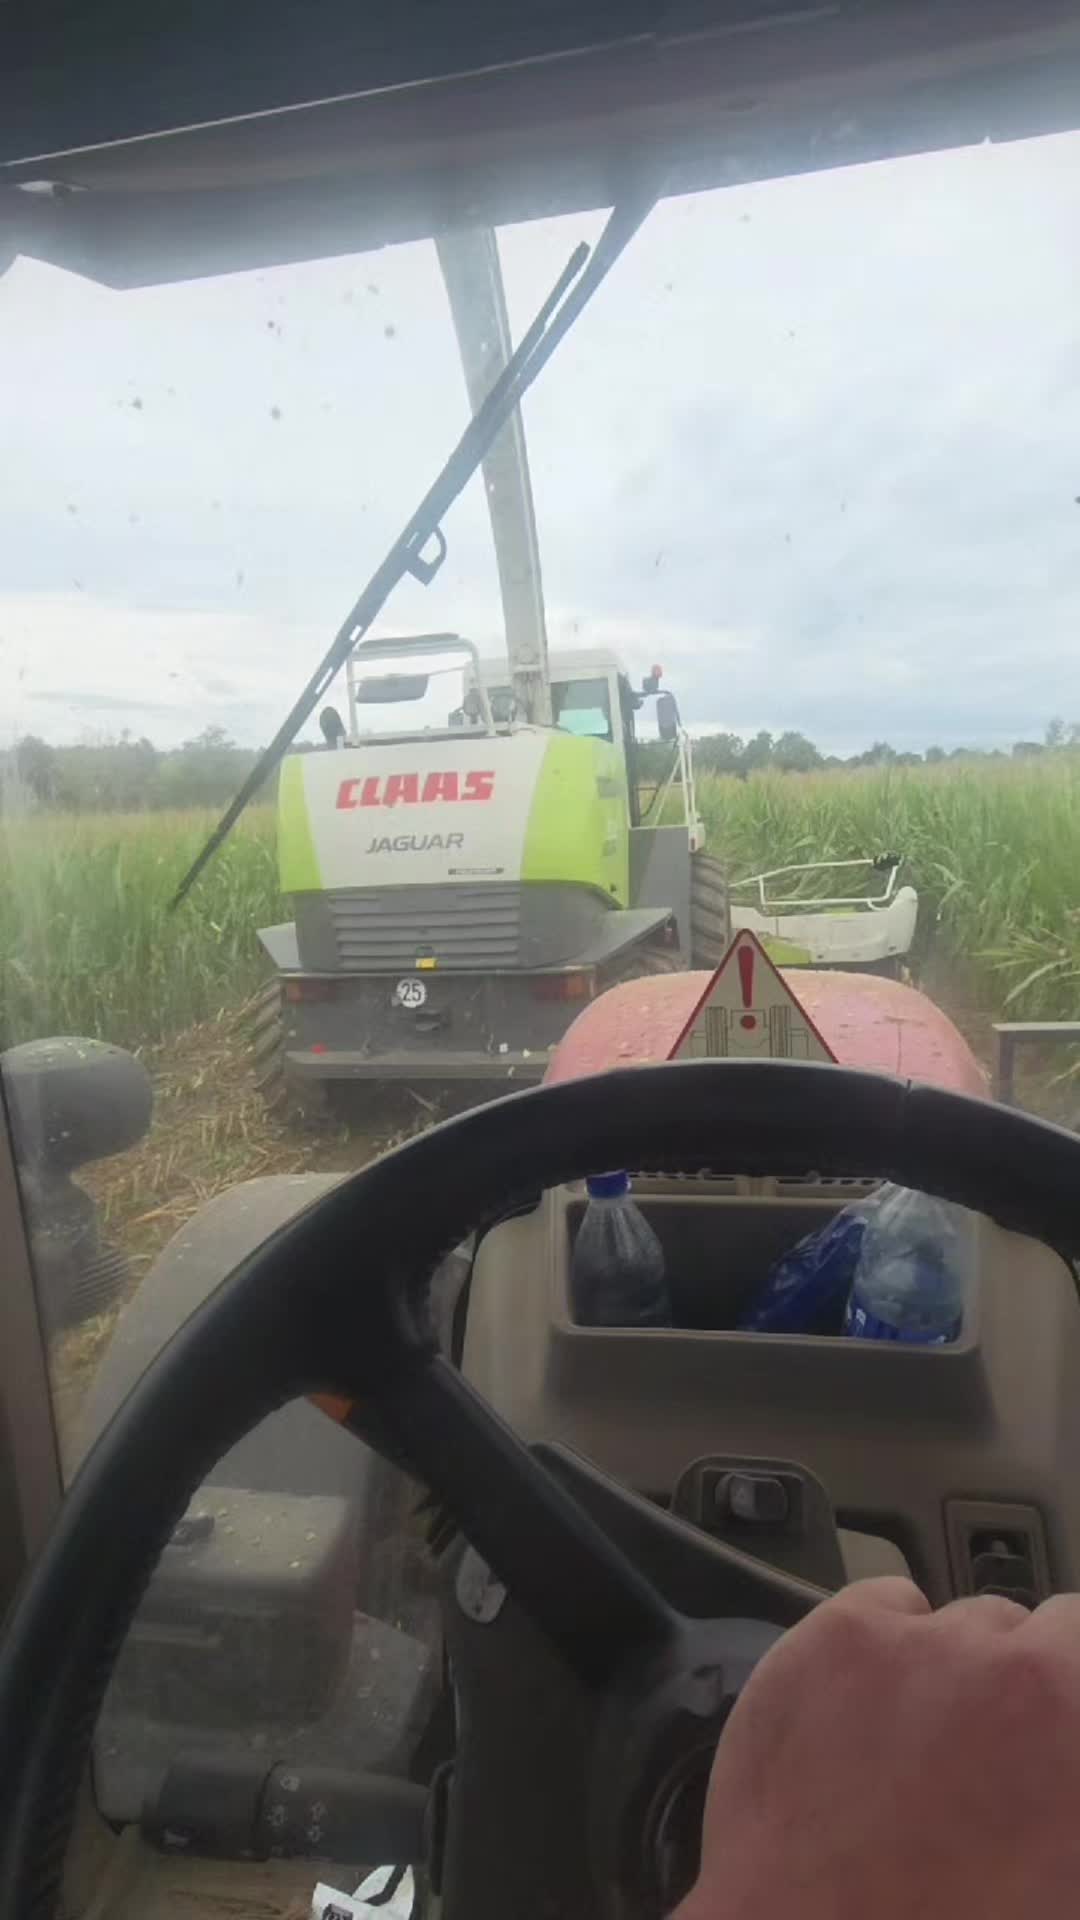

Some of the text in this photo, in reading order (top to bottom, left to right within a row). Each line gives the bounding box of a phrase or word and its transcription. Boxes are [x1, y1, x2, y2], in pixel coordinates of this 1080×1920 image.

[336, 770, 495, 809] CLAAS
[365, 832, 465, 854] JAGUAR
[400, 982, 422, 1002] 25
